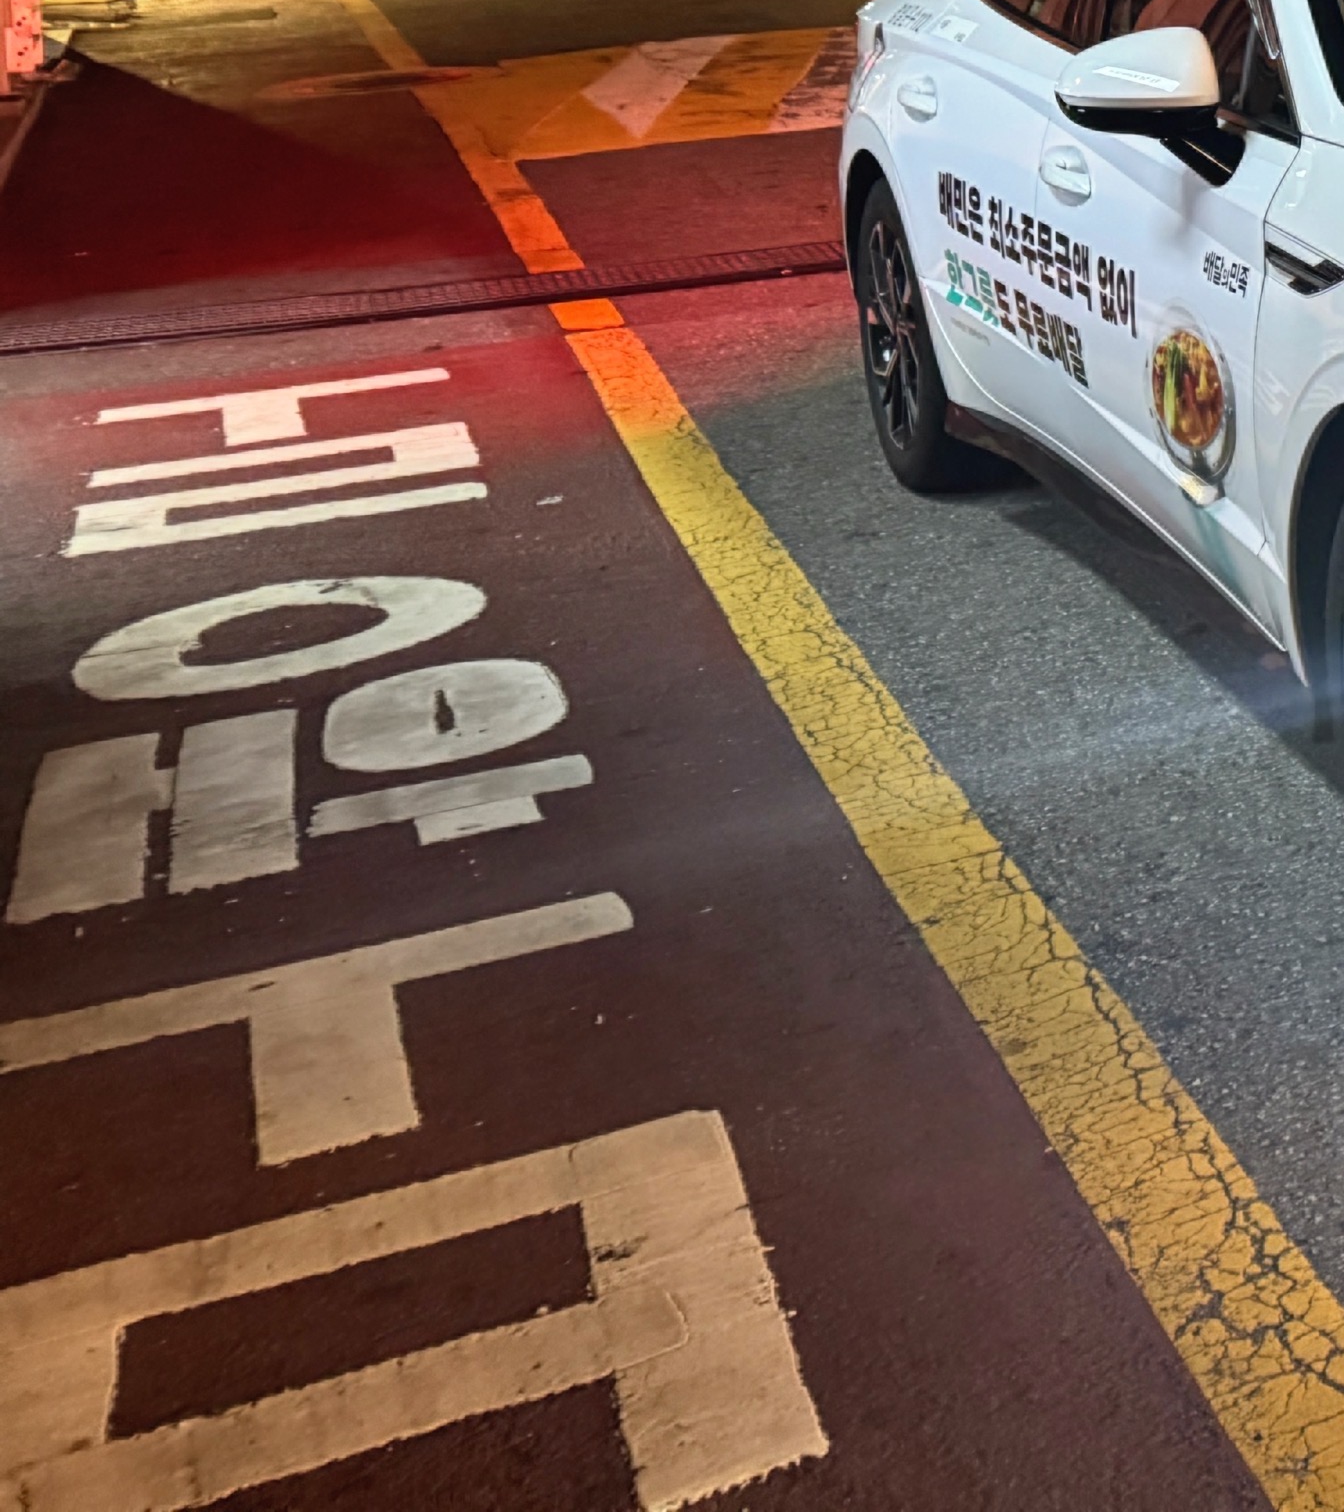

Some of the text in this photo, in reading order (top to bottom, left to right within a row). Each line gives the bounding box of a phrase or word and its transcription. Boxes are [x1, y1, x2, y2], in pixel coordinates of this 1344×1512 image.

[1097, 255, 1138, 339] 없이
[1203, 250, 1250, 299] 배달의민족
[1013, 289, 1090, 390] 무료배달
